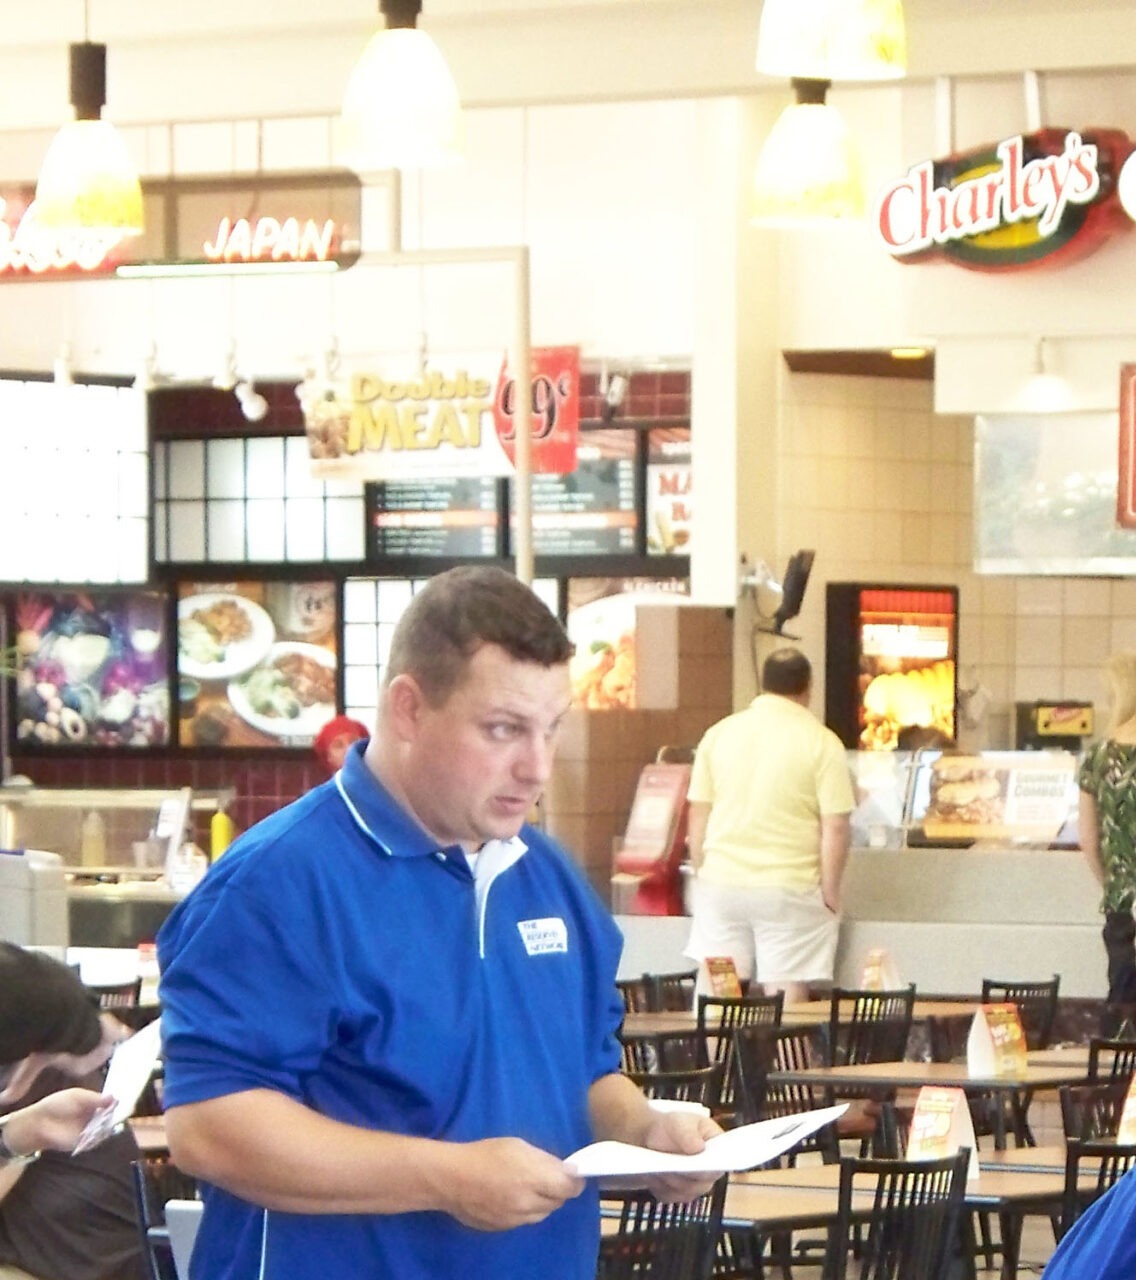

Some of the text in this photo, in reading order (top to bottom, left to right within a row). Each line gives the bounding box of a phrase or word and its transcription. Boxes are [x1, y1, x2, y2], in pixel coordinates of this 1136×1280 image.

[874, 131, 1099, 254] Charley's
[203, 216, 334, 262] JAPAN
[351, 371, 492, 402] Double
[345, 403, 489, 456] MEAT
